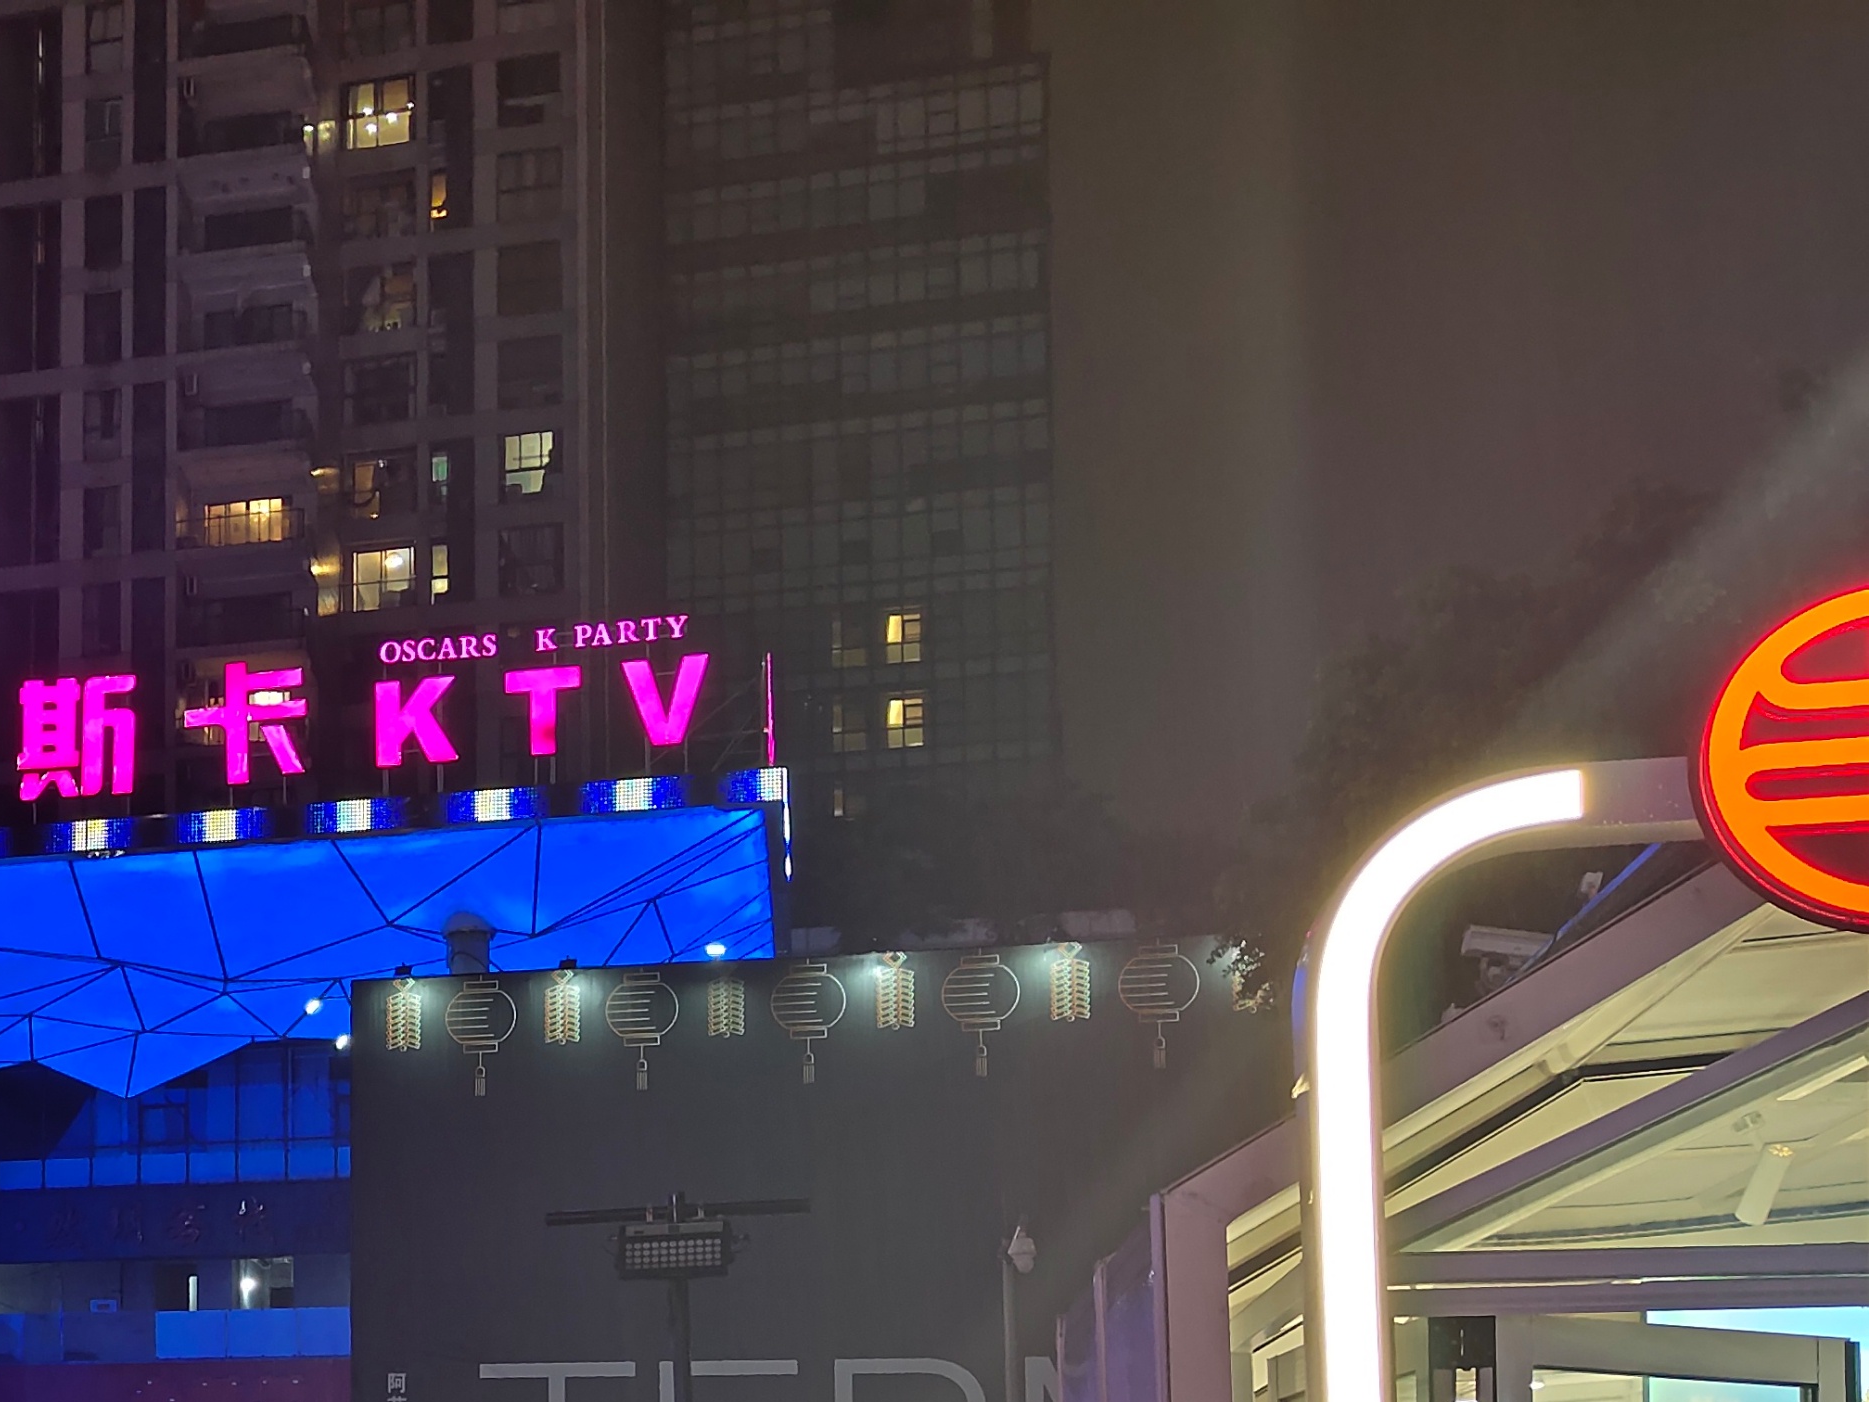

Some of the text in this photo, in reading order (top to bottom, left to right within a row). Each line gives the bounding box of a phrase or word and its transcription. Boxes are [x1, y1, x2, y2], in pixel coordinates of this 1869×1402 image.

[380, 615, 688, 664] OSCARS K PARTY
